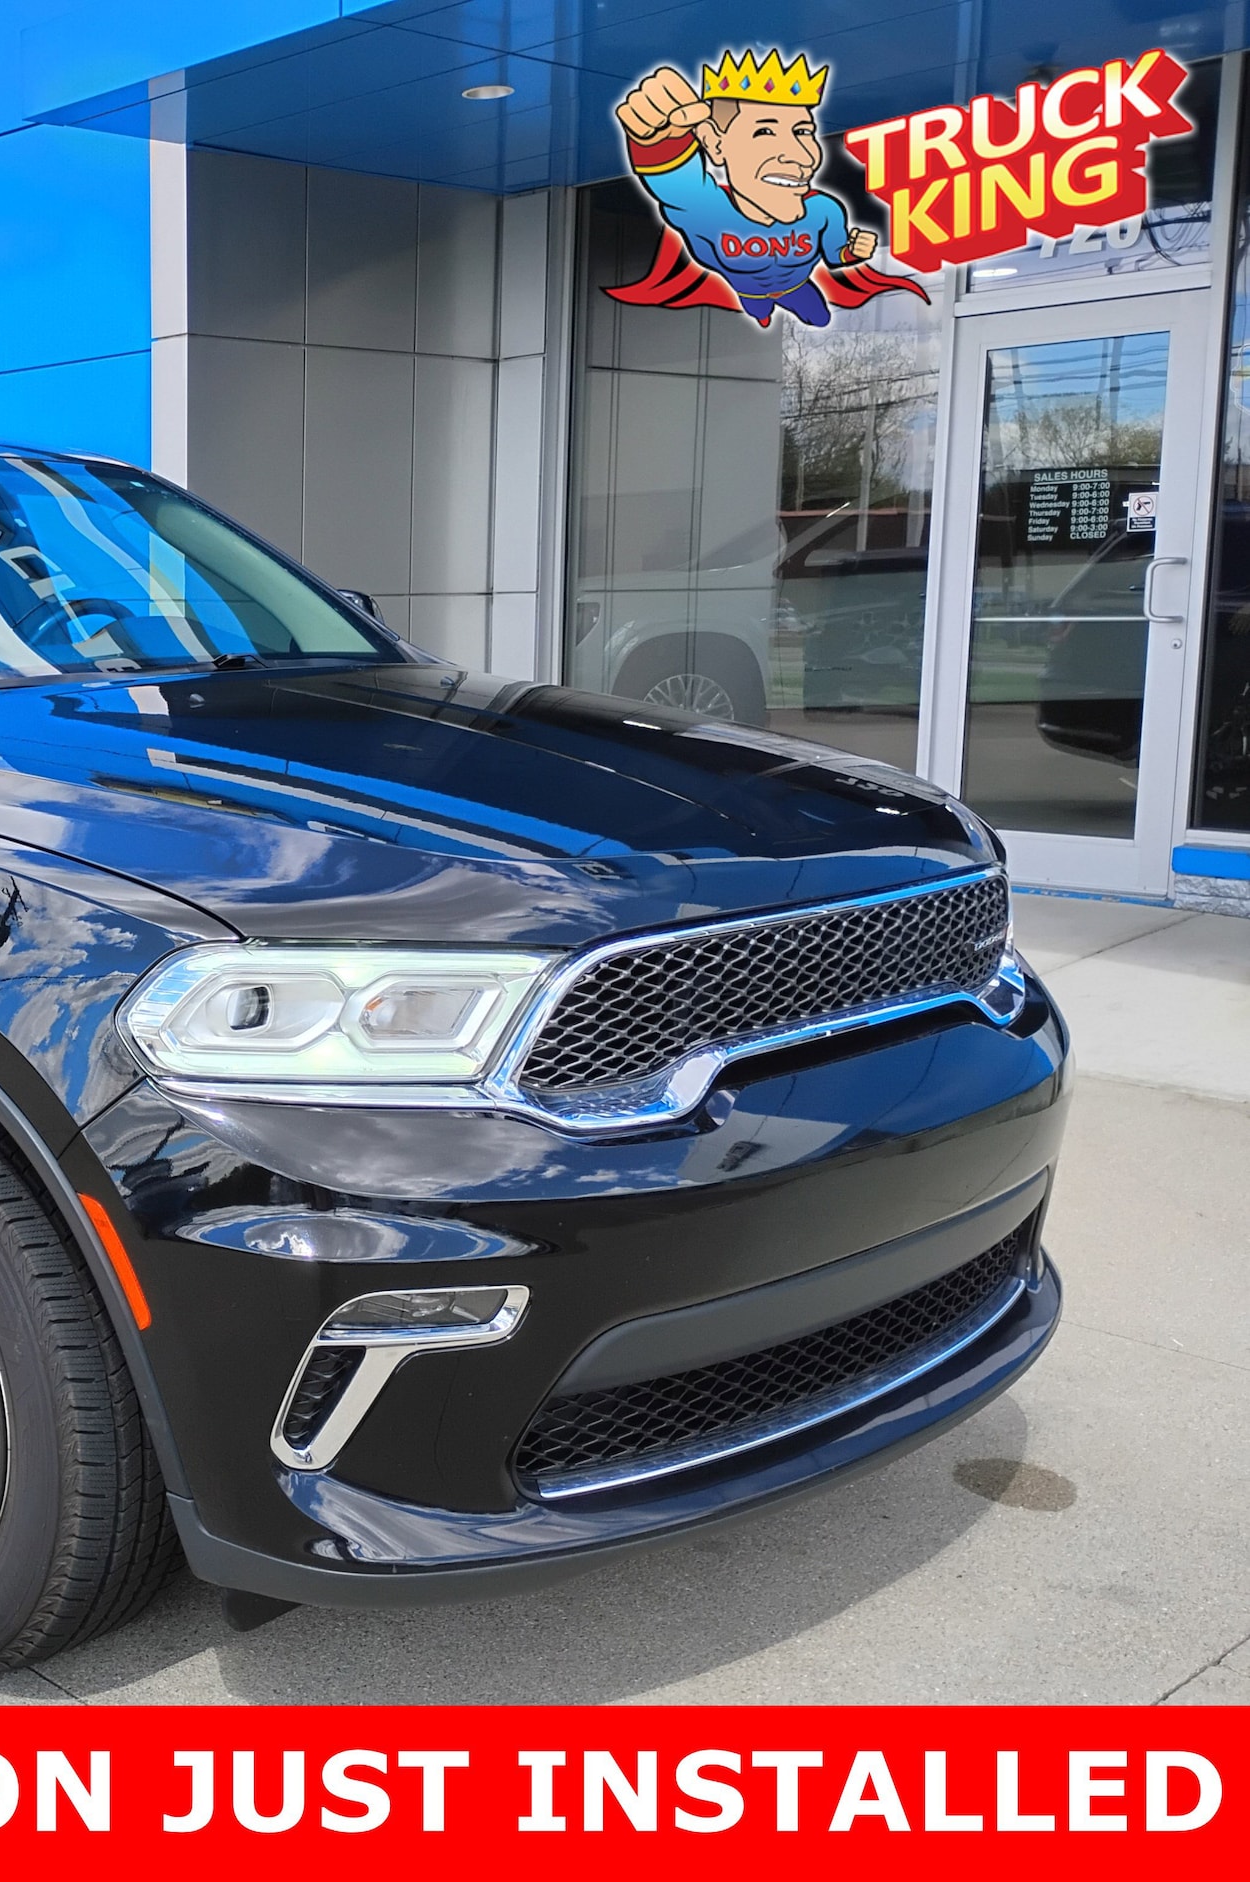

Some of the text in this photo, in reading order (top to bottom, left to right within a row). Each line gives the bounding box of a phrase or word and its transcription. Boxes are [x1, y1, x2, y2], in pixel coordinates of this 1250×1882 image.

[1034, 469, 1108, 482] SALES HOURS
[1030, 482, 1110, 493] Monday 9:00-7:00
[1072, 490, 1110, 499] 9:00-6:00
[1071, 499, 1109, 507] 9:00-6:00
[1071, 507, 1109, 515] 9:00-7:00
[1071, 515, 1108, 524] 9:00-6:00
[1070, 523, 1108, 532] 9:00-3:00
[1070, 531, 1106, 539] CLOSED
